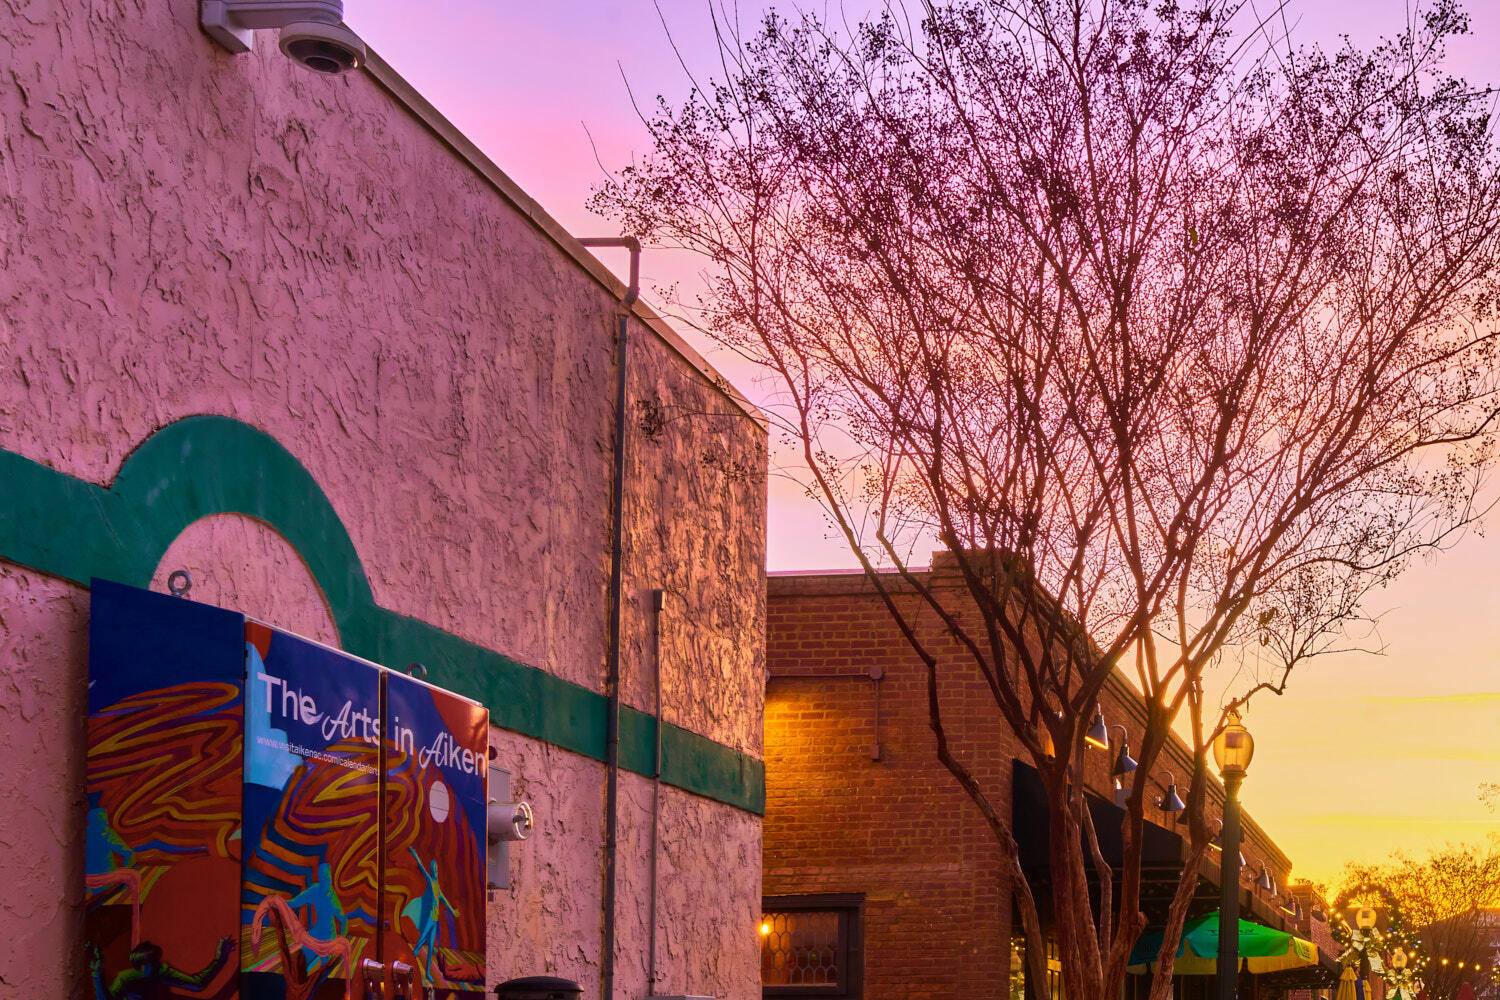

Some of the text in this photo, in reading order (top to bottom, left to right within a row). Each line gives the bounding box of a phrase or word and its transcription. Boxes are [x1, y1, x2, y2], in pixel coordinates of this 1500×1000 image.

[257, 671, 486, 779] The Arts in Aiken
